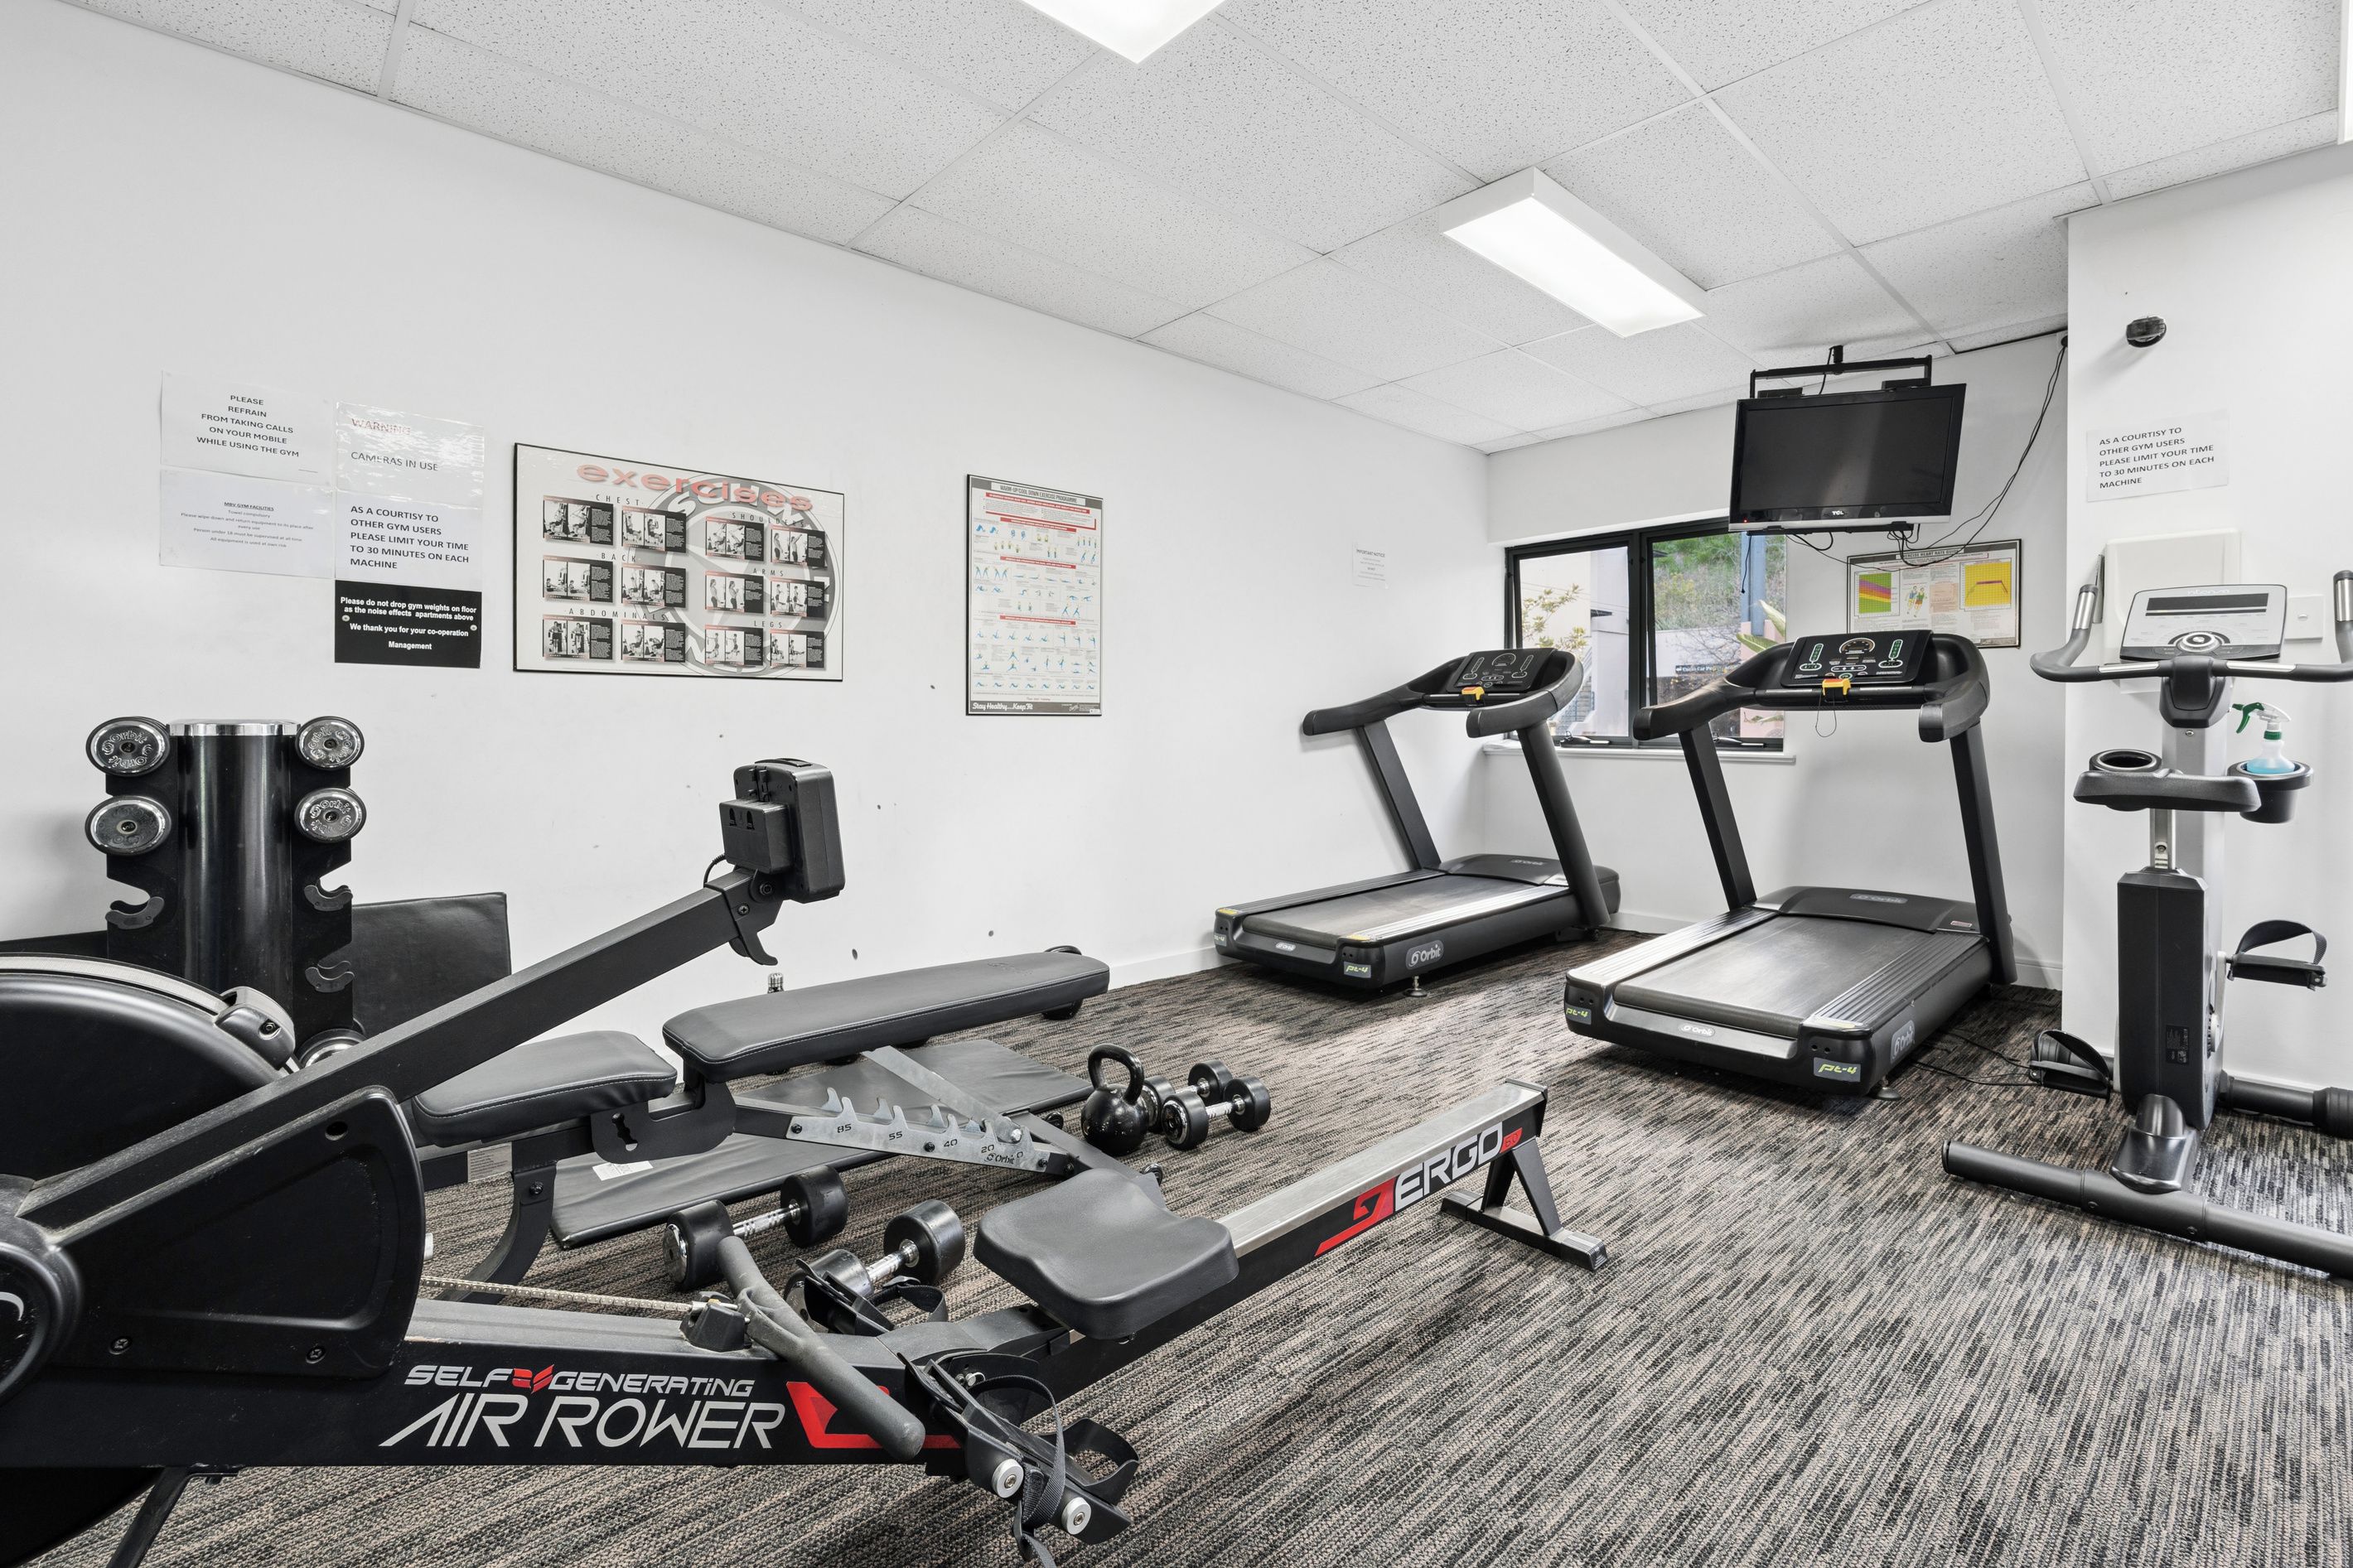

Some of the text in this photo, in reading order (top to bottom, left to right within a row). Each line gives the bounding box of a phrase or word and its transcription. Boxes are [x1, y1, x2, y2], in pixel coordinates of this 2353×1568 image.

[230, 395, 263, 405] PLEASE
[228, 406, 267, 417] REFRAIN
[201, 413, 293, 433] FROM TAKING CALLS
[351, 418, 410, 436] WARNING
[226, 429, 251, 438] YOUR
[254, 433, 287, 444] MOBILE
[2122, 430, 2167, 441] COURTISY
[196, 437, 227, 446] WHILE
[230, 441, 258, 451] USING
[280, 449, 299, 457] GYM
[2099, 437, 2185, 456] OTHER GYM USERS
[350, 451, 438, 471] CAMERAS IN USE
[2099, 445, 2214, 467] PLEASE LIMIT YOUR TIME
[2127, 462, 2169, 474] MINUTES
[2172, 460, 2186, 468] ON
[2189, 456, 2214, 465] EACH
[577, 463, 813, 511] exercises
[2099, 477, 2142, 489] MACHINE
[596, 494, 640, 506] CHEST
[350, 505, 364, 514] AS
[376, 508, 423, 521] COURTISY
[732, 512, 804, 527] SHOULDERS
[350, 519, 442, 535] OTHER GYM USERS
[350, 532, 469, 551] PLEASE LIMIT YOUR TIME
[350, 544, 469, 563] TO 30 MINUTES ON EACH
[602, 552, 637, 562] BACK
[350, 558, 398, 569] MACHINE
[753, 568, 784, 577] ARMS
[341, 596, 365, 605] Please
[390, 601, 406, 609] drop
[424, 603, 450, 612] weights
[461, 605, 476, 614] floor
[389, 608, 412, 617] effects
[415, 610, 452, 620] apartments
[454, 612, 474, 621] above
[569, 608, 666, 621] ABDOMINALS
[363, 623, 383, 632] thank
[384, 625, 398, 634] you
[399, 625, 409, 633] for
[410, 626, 426, 635] your
[428, 627, 469, 637] co-operation
[389, 640, 432, 650] Management
[973, 702, 986, 711] Stay
[1420, 944, 1441, 963] Orbit
[1692, 1027, 1714, 1036] Orbit
[837, 1123, 852, 1133] 85
[888, 1131, 903, 1141] 55
[944, 1138, 958, 1148] 40
[981, 1144, 994, 1153] 20
[995, 1153, 1015, 1164] Orbit
[1395, 1122, 1502, 1211] ERGO
[404, 1364, 755, 1397] SELF GENERATING
[379, 1392, 785, 1449] AIR ROWER
